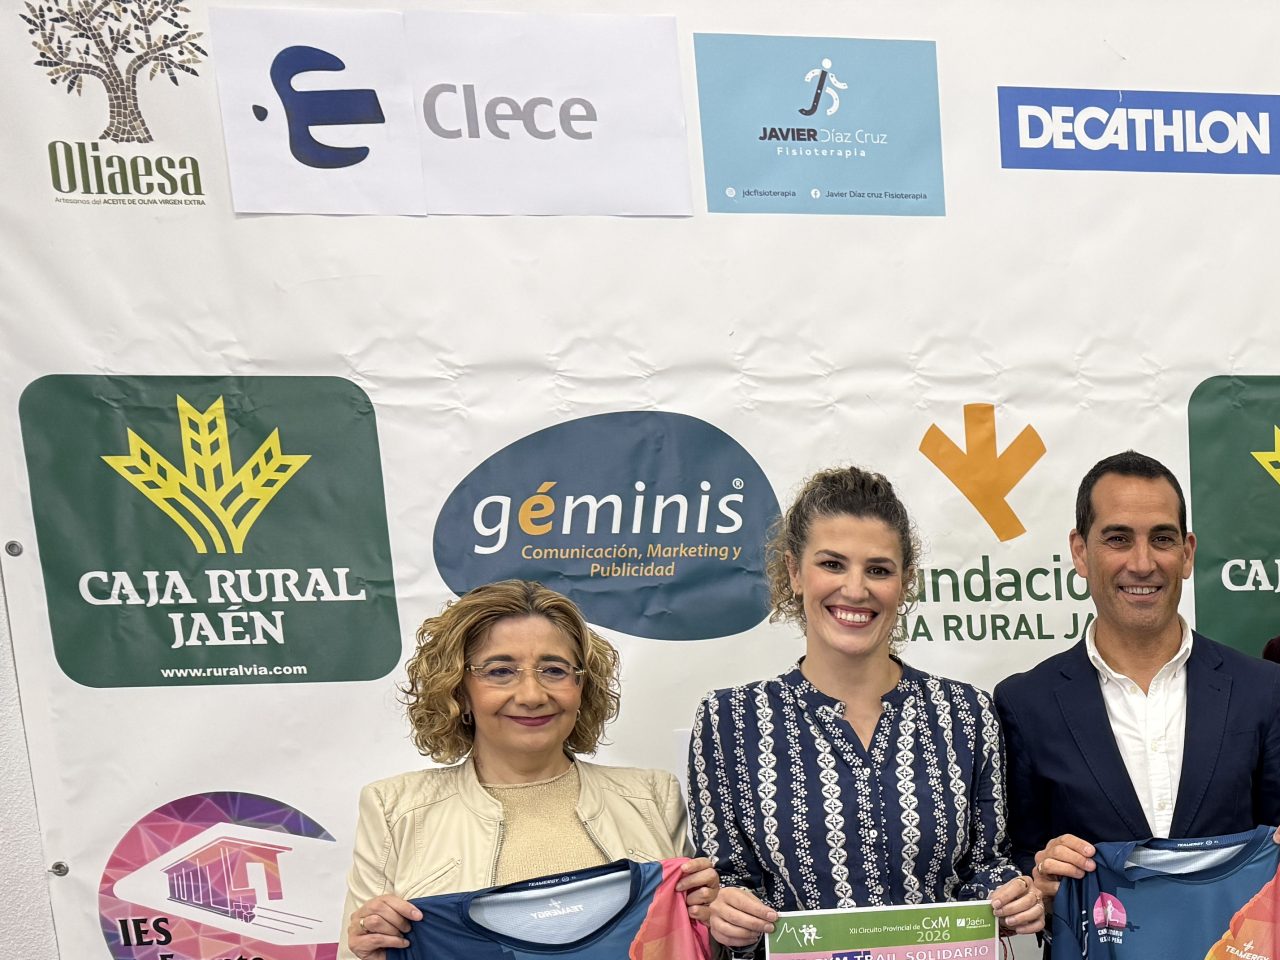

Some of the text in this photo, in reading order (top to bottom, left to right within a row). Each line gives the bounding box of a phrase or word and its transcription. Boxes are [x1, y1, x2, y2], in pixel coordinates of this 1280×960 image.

[422, 83, 598, 141] Clece
[758, 127, 888, 144] JAVIER Díaz Cruz
[1018, 105, 1270, 154] DECATHLON
[777, 147, 866, 158] Fisioterapia
[48, 140, 206, 195] Oliaesa
[825, 190, 848, 198] Javier
[521, 542, 742, 561] Comunicación, Marketing y
[590, 562, 676, 578] Publicidad
[78, 567, 367, 607] CAJA RURAL
[168, 603, 285, 649] JAÉN
[943, 614, 1055, 641] RURAL
[160, 664, 308, 679] www.ruralvia.com
[528, 878, 560, 888] TEAMERGY
[118, 918, 173, 947] IES
[858, 926, 882, 934] Circuito
[882, 924, 912, 933] Provincial
[912, 923, 920, 931] de
[921, 916, 950, 930] CxM
[916, 930, 951, 943] 2026
